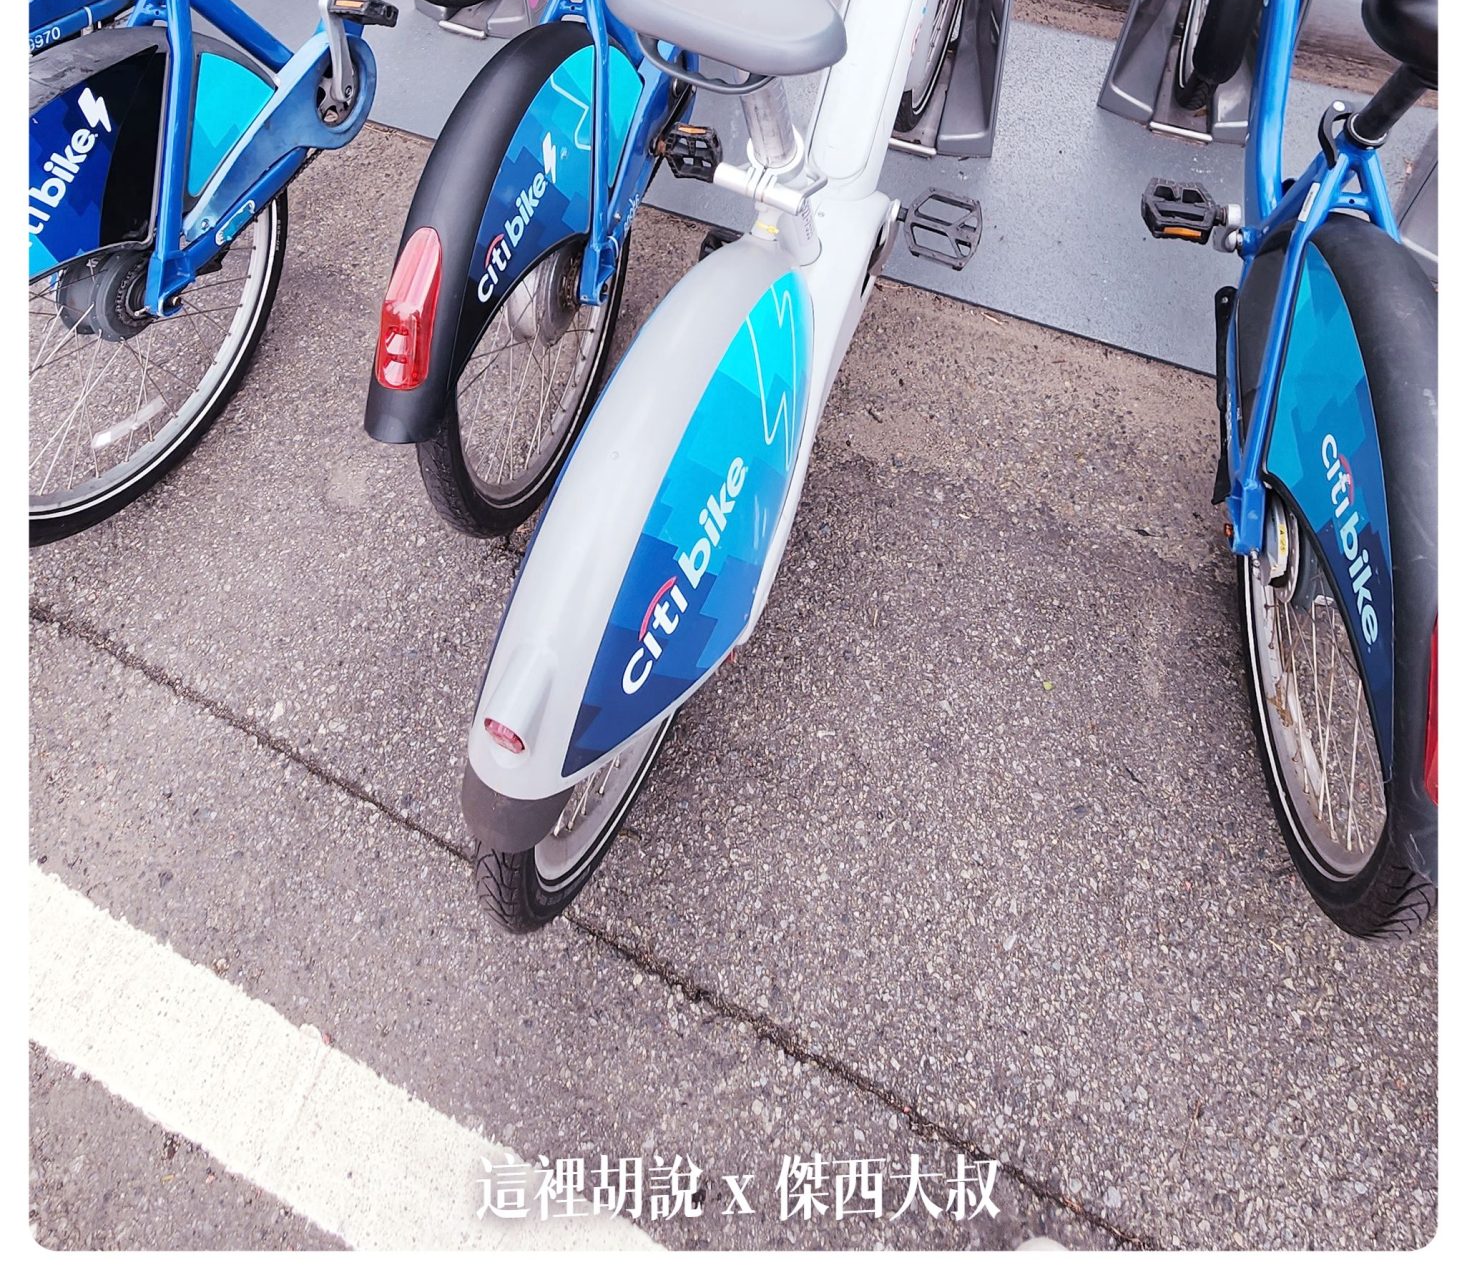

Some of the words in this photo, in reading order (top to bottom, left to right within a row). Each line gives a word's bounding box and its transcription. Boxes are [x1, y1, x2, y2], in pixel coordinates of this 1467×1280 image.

[29, 128, 96, 208] bike
[477, 233, 512, 303] citi
[504, 172, 547, 248] bike
[621, 576, 688, 695] citi
[678, 456, 747, 590] bike
[1321, 433, 1354, 519] citi
[1340, 510, 1378, 646] bike
